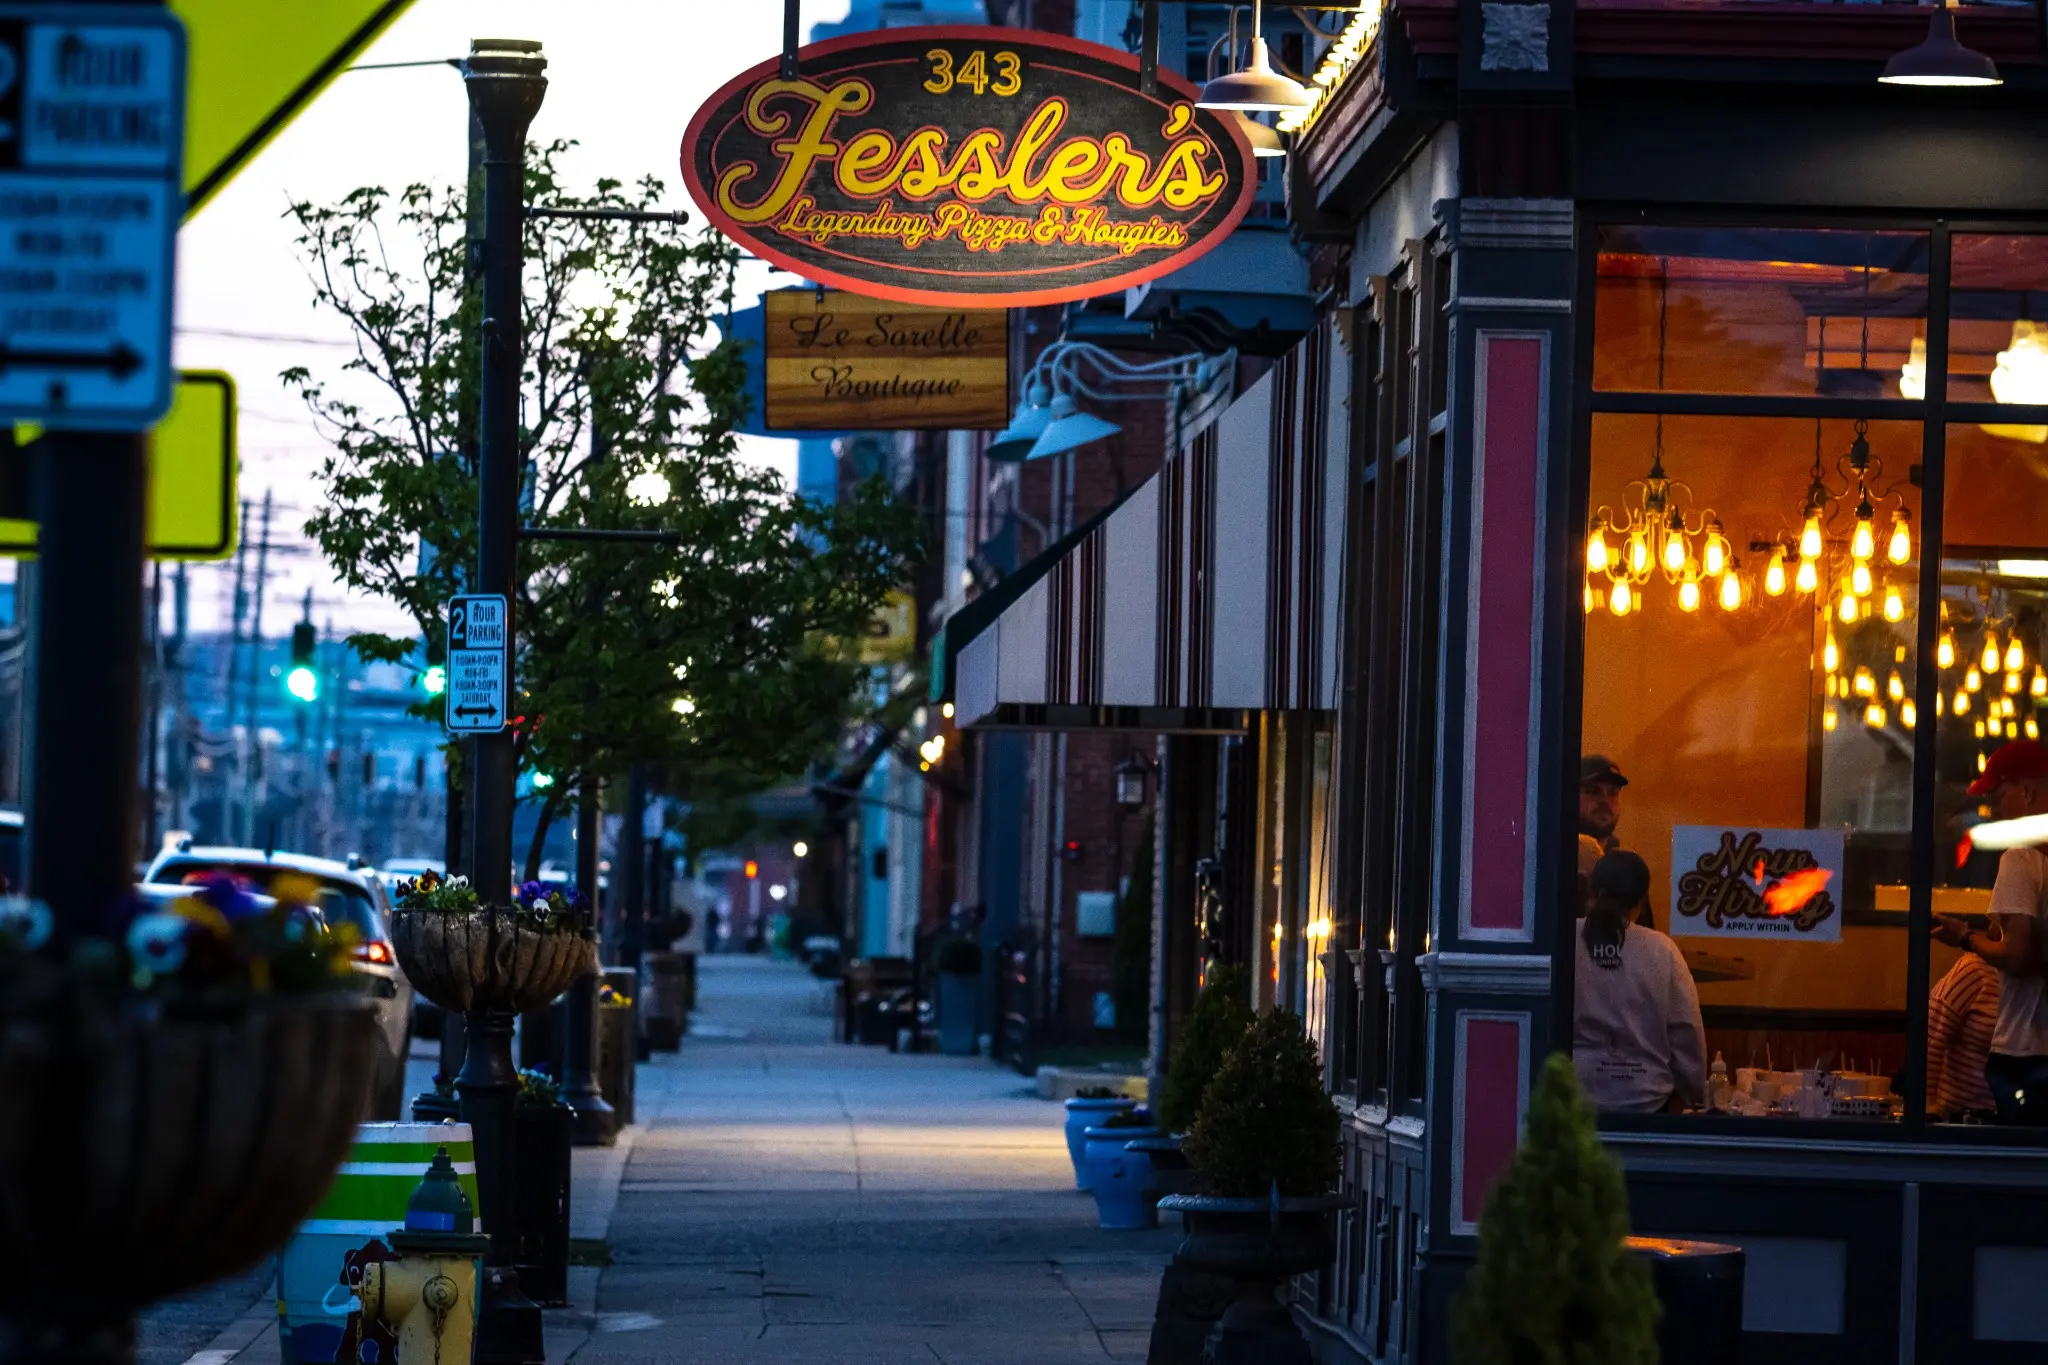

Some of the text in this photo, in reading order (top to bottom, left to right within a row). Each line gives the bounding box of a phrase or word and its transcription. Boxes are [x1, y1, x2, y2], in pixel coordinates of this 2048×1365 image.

[922, 49, 1023, 97] 343
[716, 76, 1229, 228] Fessler's
[775, 196, 1187, 256] Legendary Pizza & Hoagies
[789, 312, 980, 349] Le Sorelle
[810, 362, 964, 405] Boutique
[451, 606, 465, 641] 2
[468, 625, 502, 641] PARKING
[473, 605, 496, 622] HOUR
[1697, 831, 1819, 877] Now
[1677, 871, 1835, 932] Hirg
[1726, 921, 1790, 933] APPLY WITHIN
